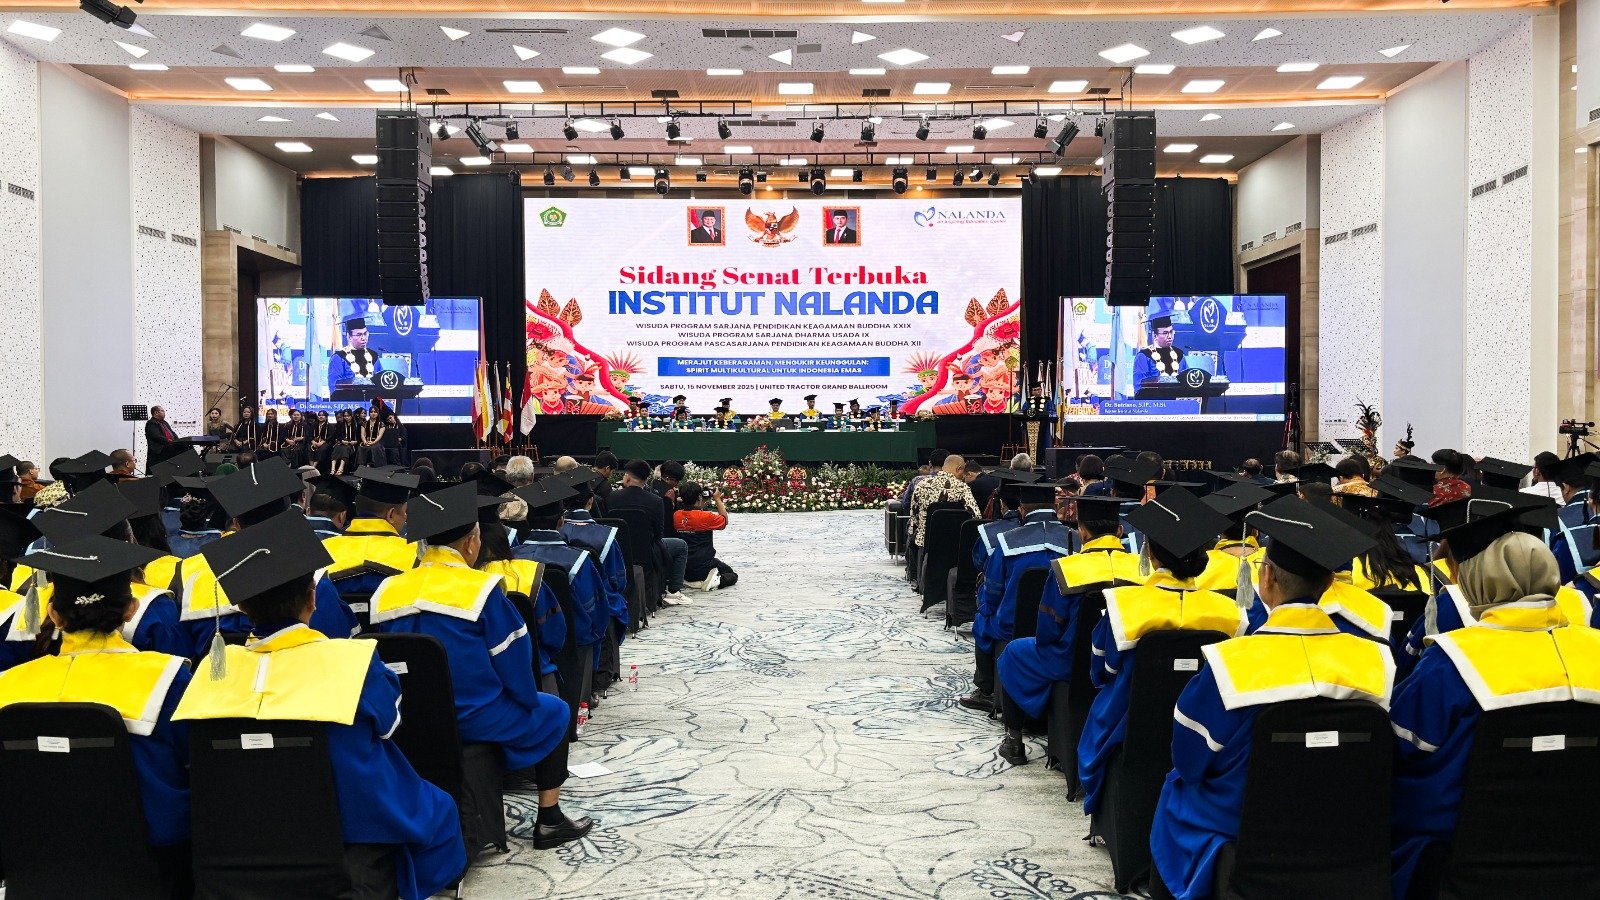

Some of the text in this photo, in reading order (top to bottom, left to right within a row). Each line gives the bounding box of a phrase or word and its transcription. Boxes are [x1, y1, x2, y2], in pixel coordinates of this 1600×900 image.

[938, 211, 1005, 219] NALANDA
[619, 265, 928, 290] Sidang Senat Terbuka
[608, 290, 939, 315] INSTITUT NALANDA
